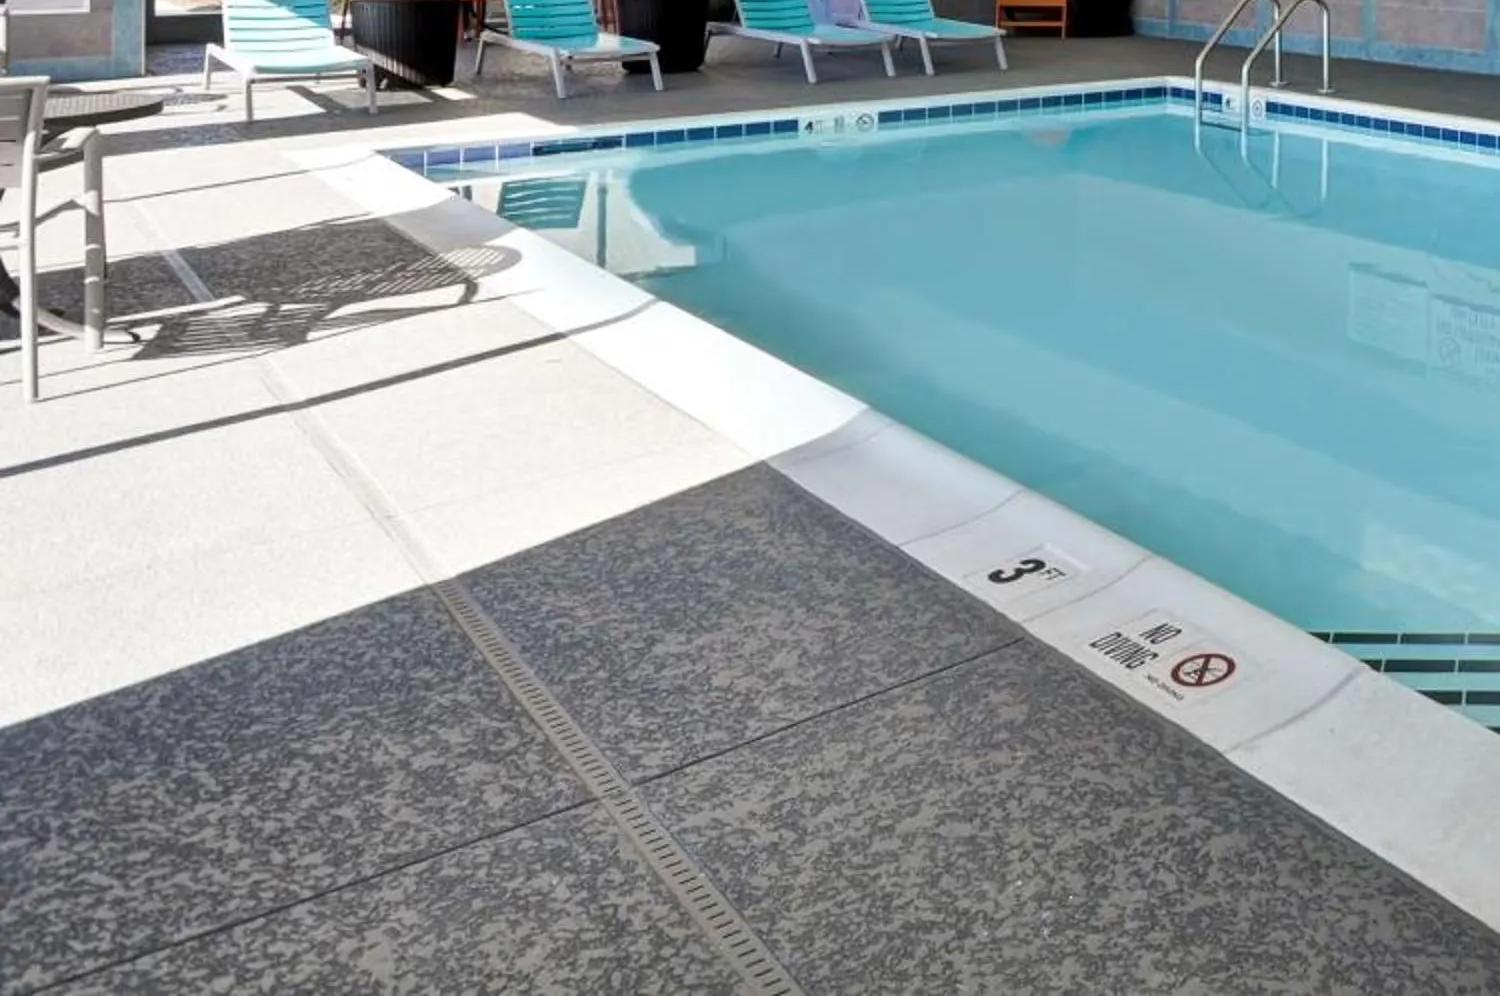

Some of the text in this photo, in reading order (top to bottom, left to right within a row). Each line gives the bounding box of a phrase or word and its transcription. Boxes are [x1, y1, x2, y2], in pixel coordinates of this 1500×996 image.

[988, 558, 1046, 584] 3
[1139, 623, 1182, 645] NO
[1089, 632, 1158, 669] DIVING
